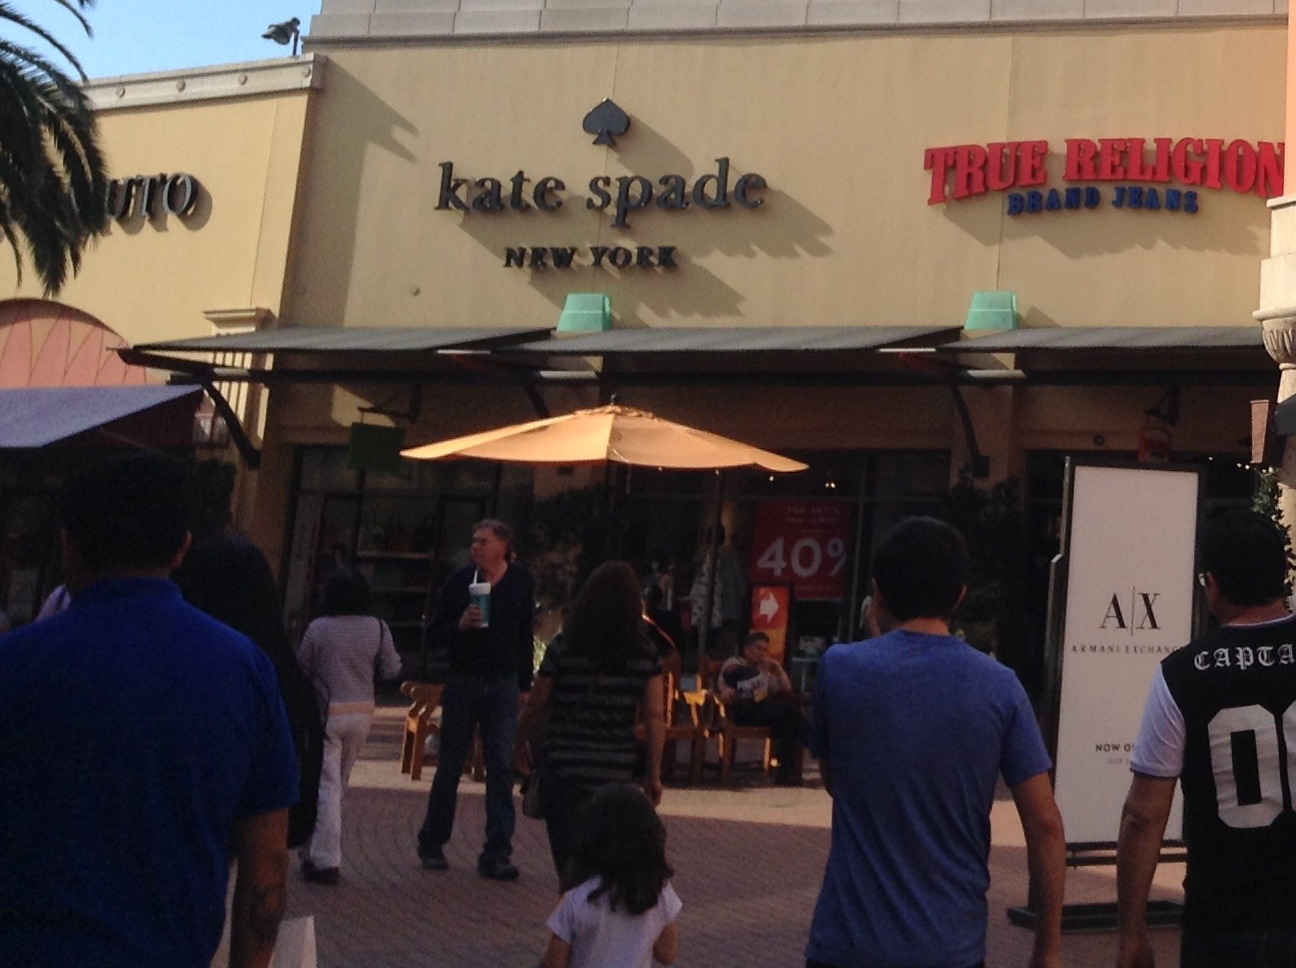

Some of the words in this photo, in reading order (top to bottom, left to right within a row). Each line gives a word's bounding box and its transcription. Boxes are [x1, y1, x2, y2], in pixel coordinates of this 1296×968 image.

[924, 140, 1048, 206] TRUE
[1062, 137, 1284, 198] RELIGION
[104, 173, 199, 220] UTO
[434, 161, 566, 213] kate
[586, 156, 768, 229] spade
[1007, 186, 1101, 215] BRAND
[1112, 186, 1199, 214] JEANS
[503, 246, 577, 268] NEW
[589, 245, 678, 269] YORK
[1071, 645, 1120, 655] ARMANI
[1095, 743, 1120, 753] NOW
